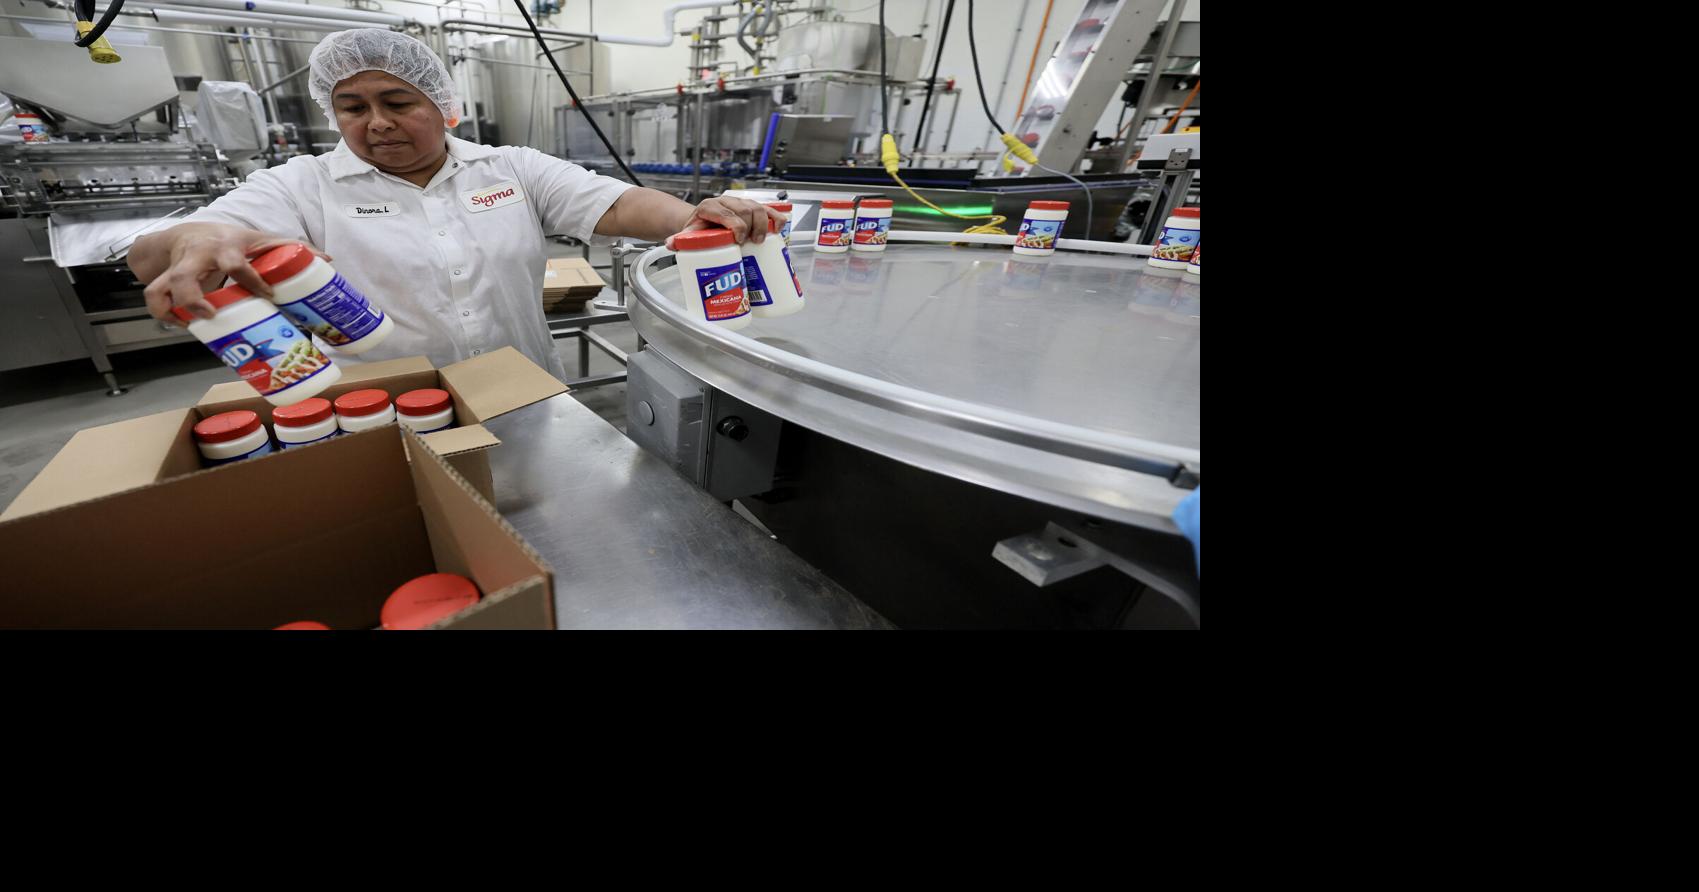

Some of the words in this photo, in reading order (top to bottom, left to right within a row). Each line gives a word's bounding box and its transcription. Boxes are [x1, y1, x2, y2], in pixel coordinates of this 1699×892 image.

[471, 187, 515, 207] Sigma
[384, 205, 390, 213] L
[821, 223, 844, 233] FUD
[856, 221, 878, 231] FUD
[704, 271, 742, 298] FUD
[222, 343, 255, 368] UD
